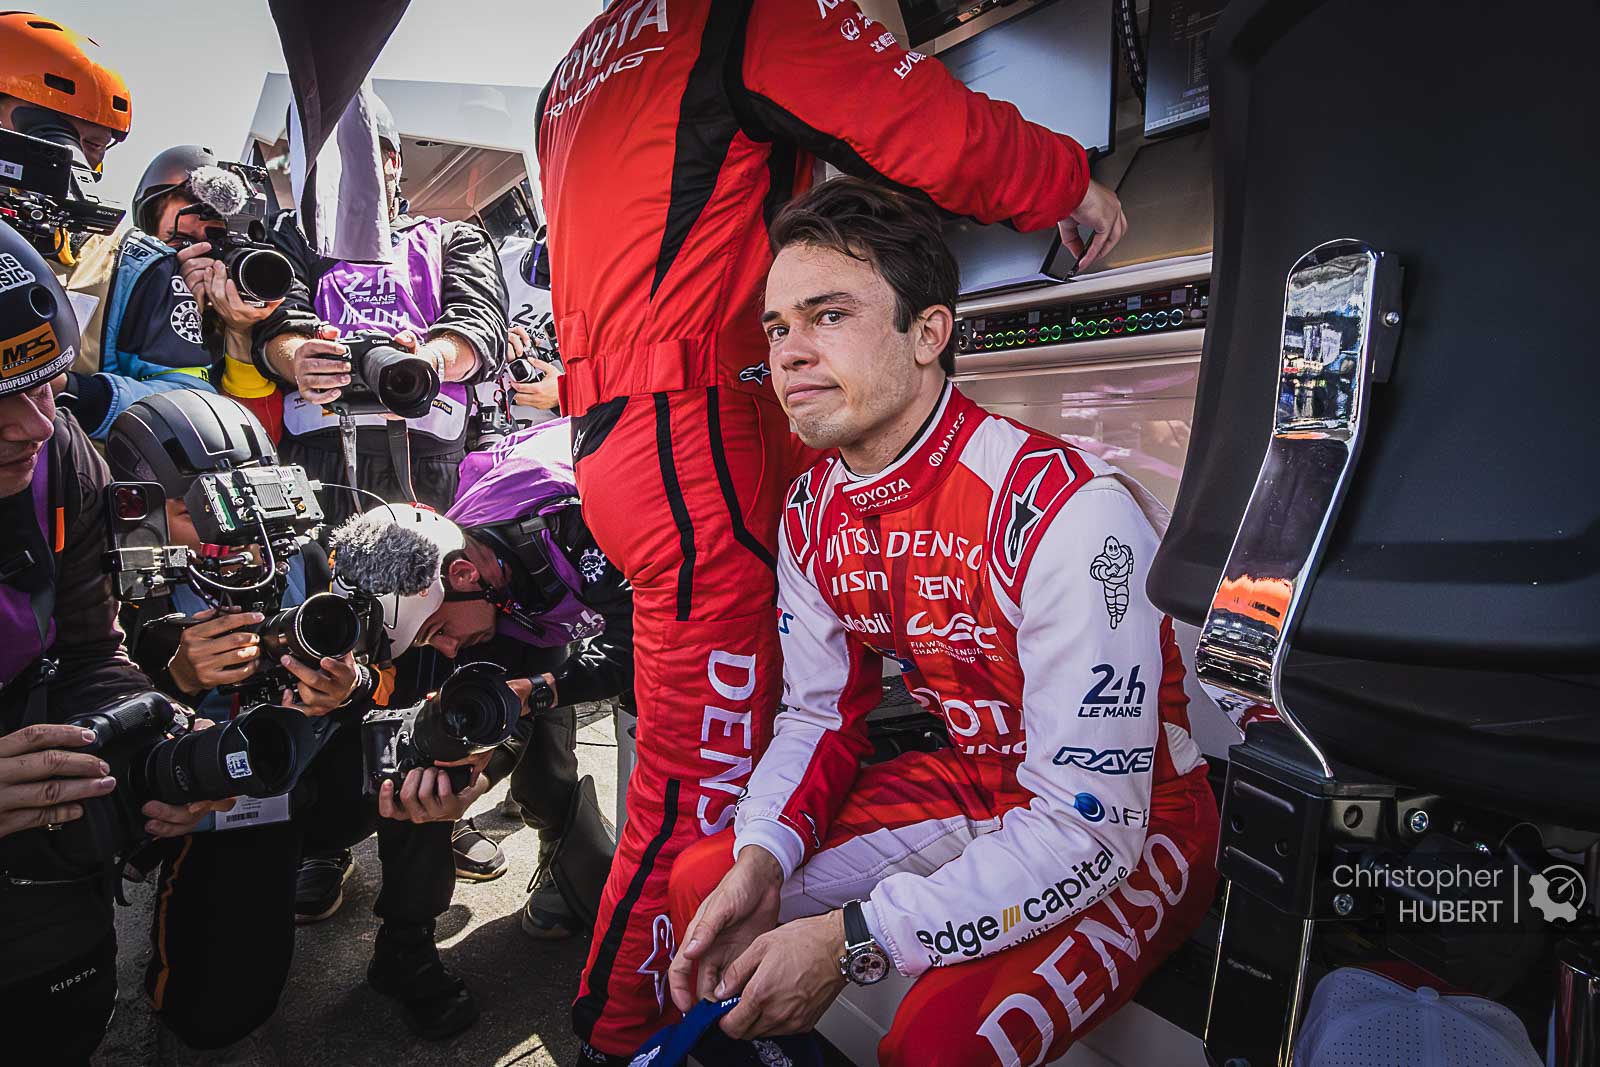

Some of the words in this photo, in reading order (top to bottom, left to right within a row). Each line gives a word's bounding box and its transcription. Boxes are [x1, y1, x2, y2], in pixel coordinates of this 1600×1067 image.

[551, 0, 669, 99] TOYOTA
[544, 47, 665, 121] RACING
[97, 209, 119, 217] SONY
[0, 374, 31, 391] UROPEAN
[849, 478, 912, 506] TOYOTA
[856, 494, 911, 513] RACING
[826, 527, 881, 568] JITSU
[886, 529, 983, 571] DENSO
[840, 612, 891, 634] Mobil
[906, 610, 998, 649] WEC
[911, 641, 925, 649] FIA
[955, 647, 1004, 662] ENDURNC
[913, 647, 976, 664] CHAMONSHIP
[1082, 663, 1147, 705] 24h
[1077, 706, 1101, 718] LE
[1103, 706, 1142, 718] MANS
[697, 649, 757, 837] DENS
[1052, 746, 1155, 775] RAYS
[915, 915, 1000, 957] edge
[1023, 837, 1115, 922] capital
[976, 833, 1190, 1067] DENSO
[50, 967, 97, 993] KIPSTA
